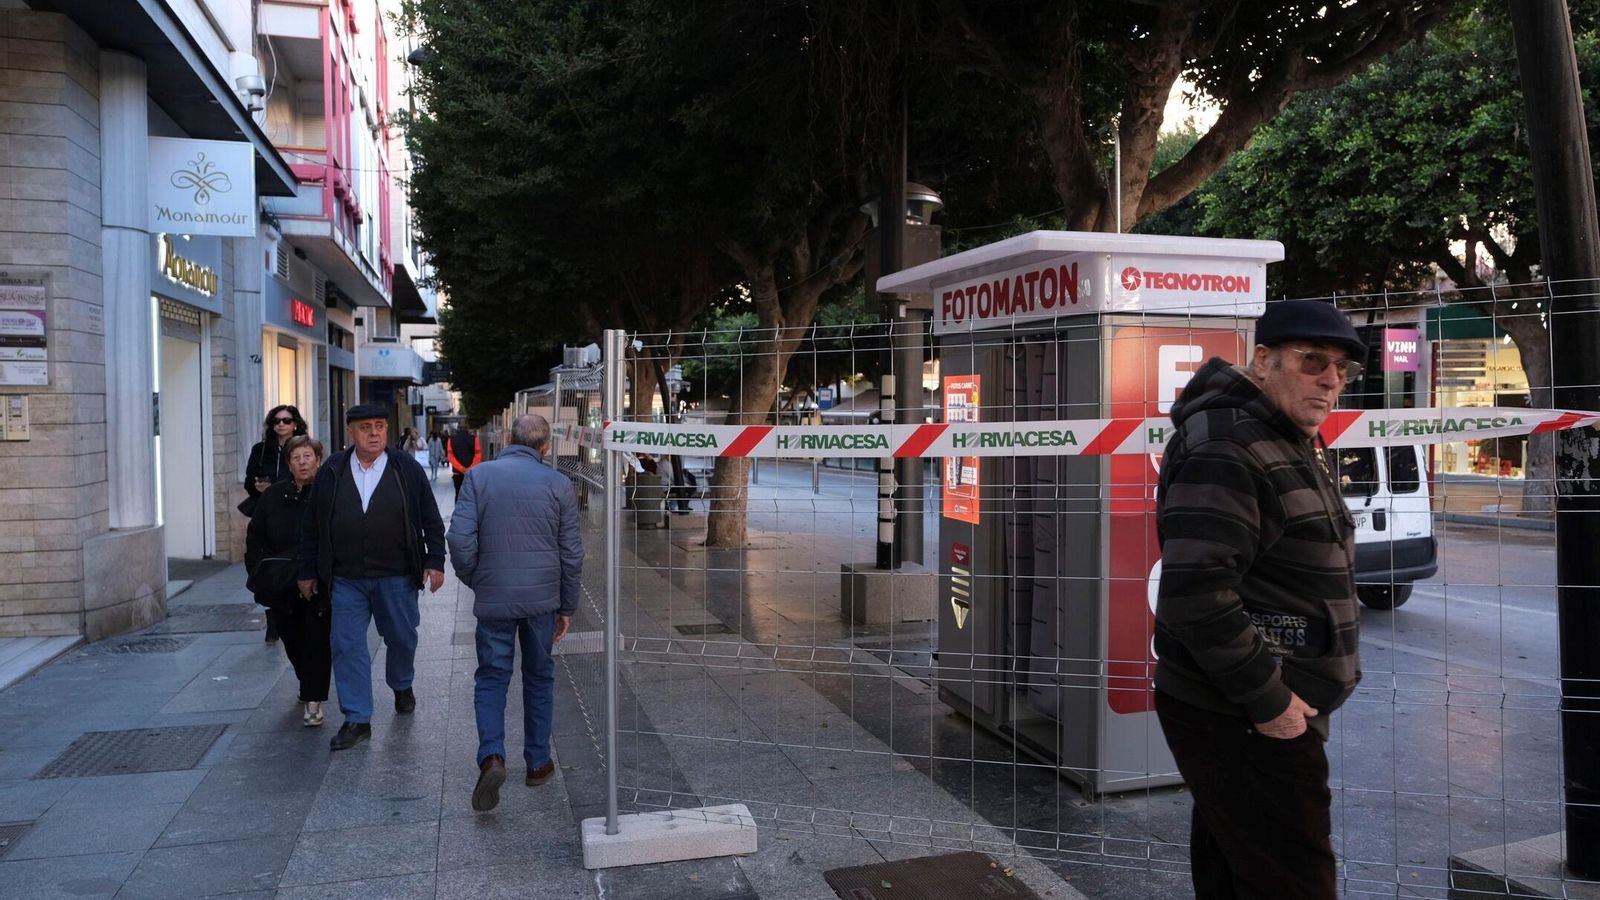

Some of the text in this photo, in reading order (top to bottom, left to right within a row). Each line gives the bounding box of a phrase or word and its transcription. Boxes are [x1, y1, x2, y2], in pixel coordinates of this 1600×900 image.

[154, 205, 248, 225] Monamour
[1143, 271, 1251, 293] TECNOTRON
[942, 262, 1078, 326] FOTOMATON
[1387, 341, 1417, 353] VINH
[612, 430, 718, 448] HORMACESA
[777, 433, 889, 449] HORMACESA
[952, 430, 1078, 448] HORMACESA
[1251, 612, 1308, 628] SPORTS
